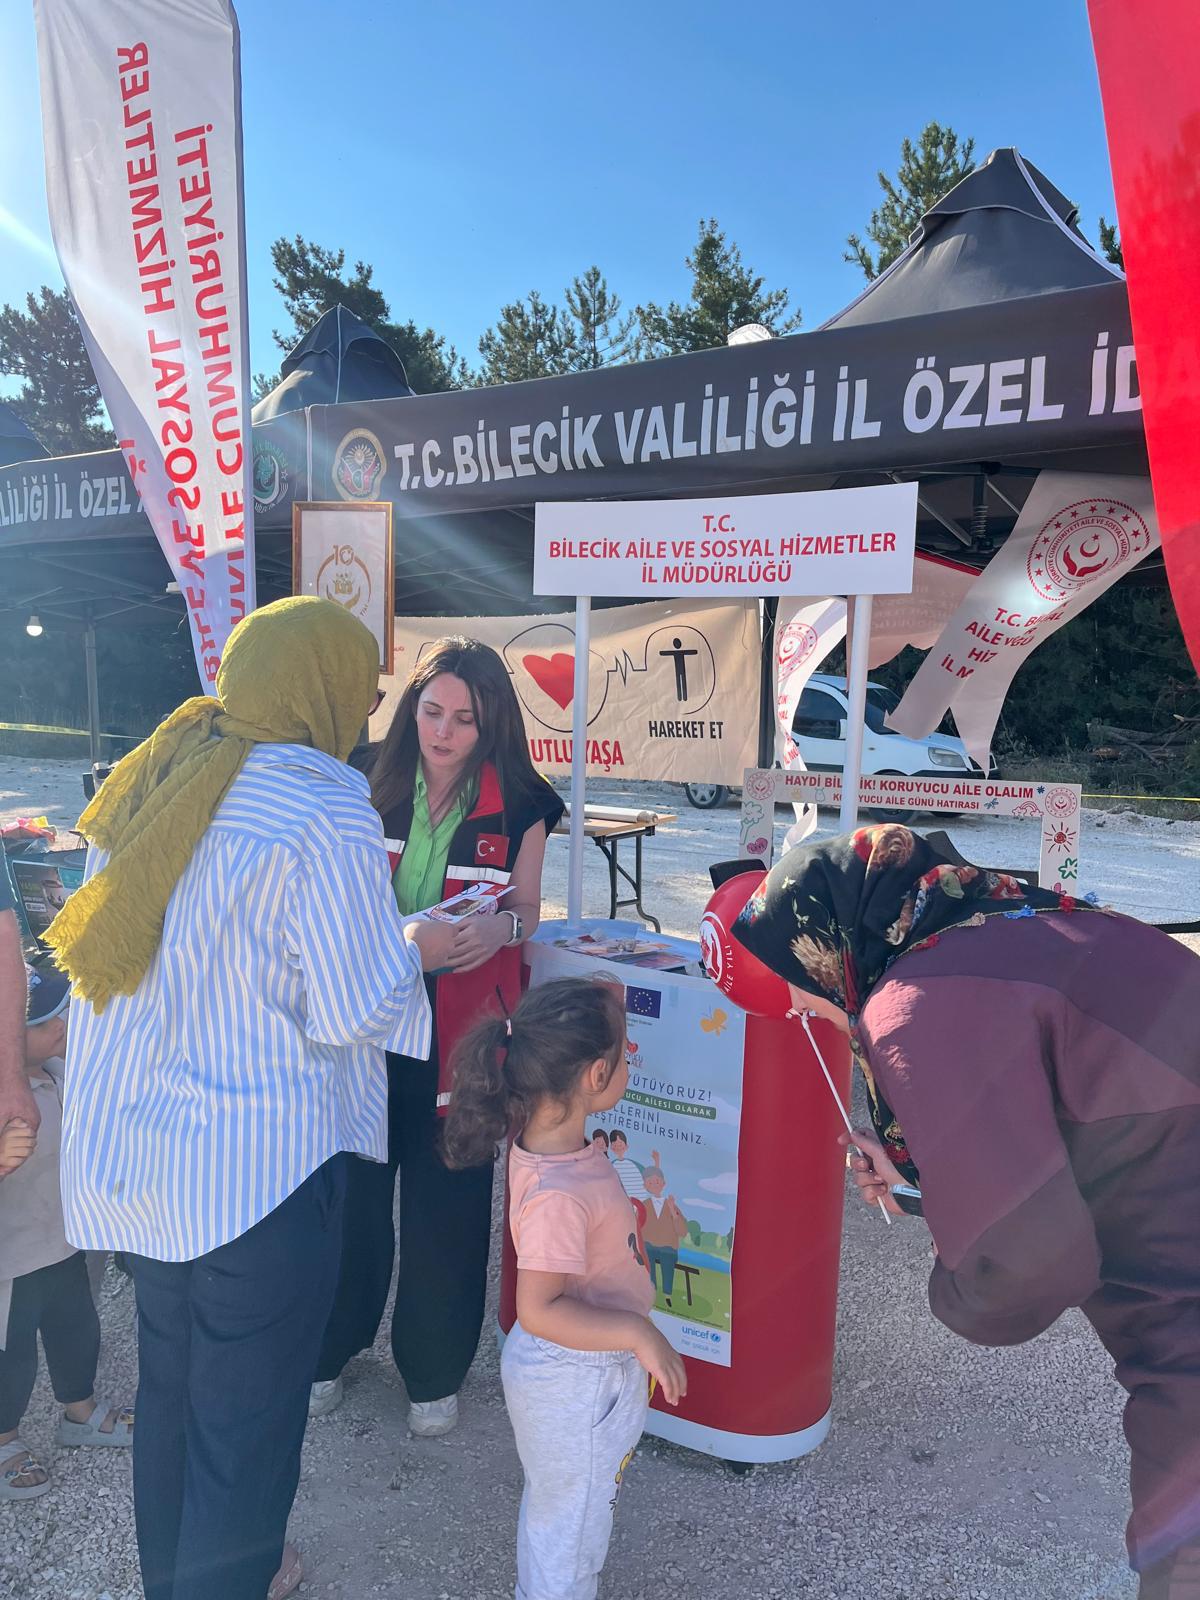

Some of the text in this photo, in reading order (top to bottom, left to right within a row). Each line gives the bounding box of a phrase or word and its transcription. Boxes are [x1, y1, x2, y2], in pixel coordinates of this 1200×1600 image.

[614, 369, 816, 465] VALİLİĞİ
[832, 365, 882, 442] İL
[902, 355, 1065, 434] ÖZEL
[1088, 331, 1143, 416] İD
[0, 470, 132, 527] LİLİĞİ İL ÖZEL
[702, 514, 736, 533] T.C.
[549, 532, 897, 559] BİLECİK AİLE VE SOSYAL HİZMETLER
[641, 560, 793, 584] İL MÜDÜRLÜĞÜ
[994, 607, 1022, 627] T.C.
[965, 621, 1005, 646] AİLE
[648, 720, 724, 740] HAREKET ET
[530, 738, 573, 764] UTLU
[785, 774, 820, 787] HAYDİ
[880, 780, 950, 795] KORUYUCU
[953, 782, 982, 796] AİLE
[985, 786, 1034, 799] OLALIM
[885, 795, 907, 806] AİLE
[907, 797, 934, 807] GÜNÜ
[936, 799, 980, 810] HATIRASI
[628, 1073, 712, 1102] ÜTÜYORUZ!
[613, 1103, 660, 1124] LLERİNİ
[644, 1095, 671, 1110] AİLESİ
[675, 1104, 712, 1117] OLARAK
[681, 1325, 709, 1339] unicef
